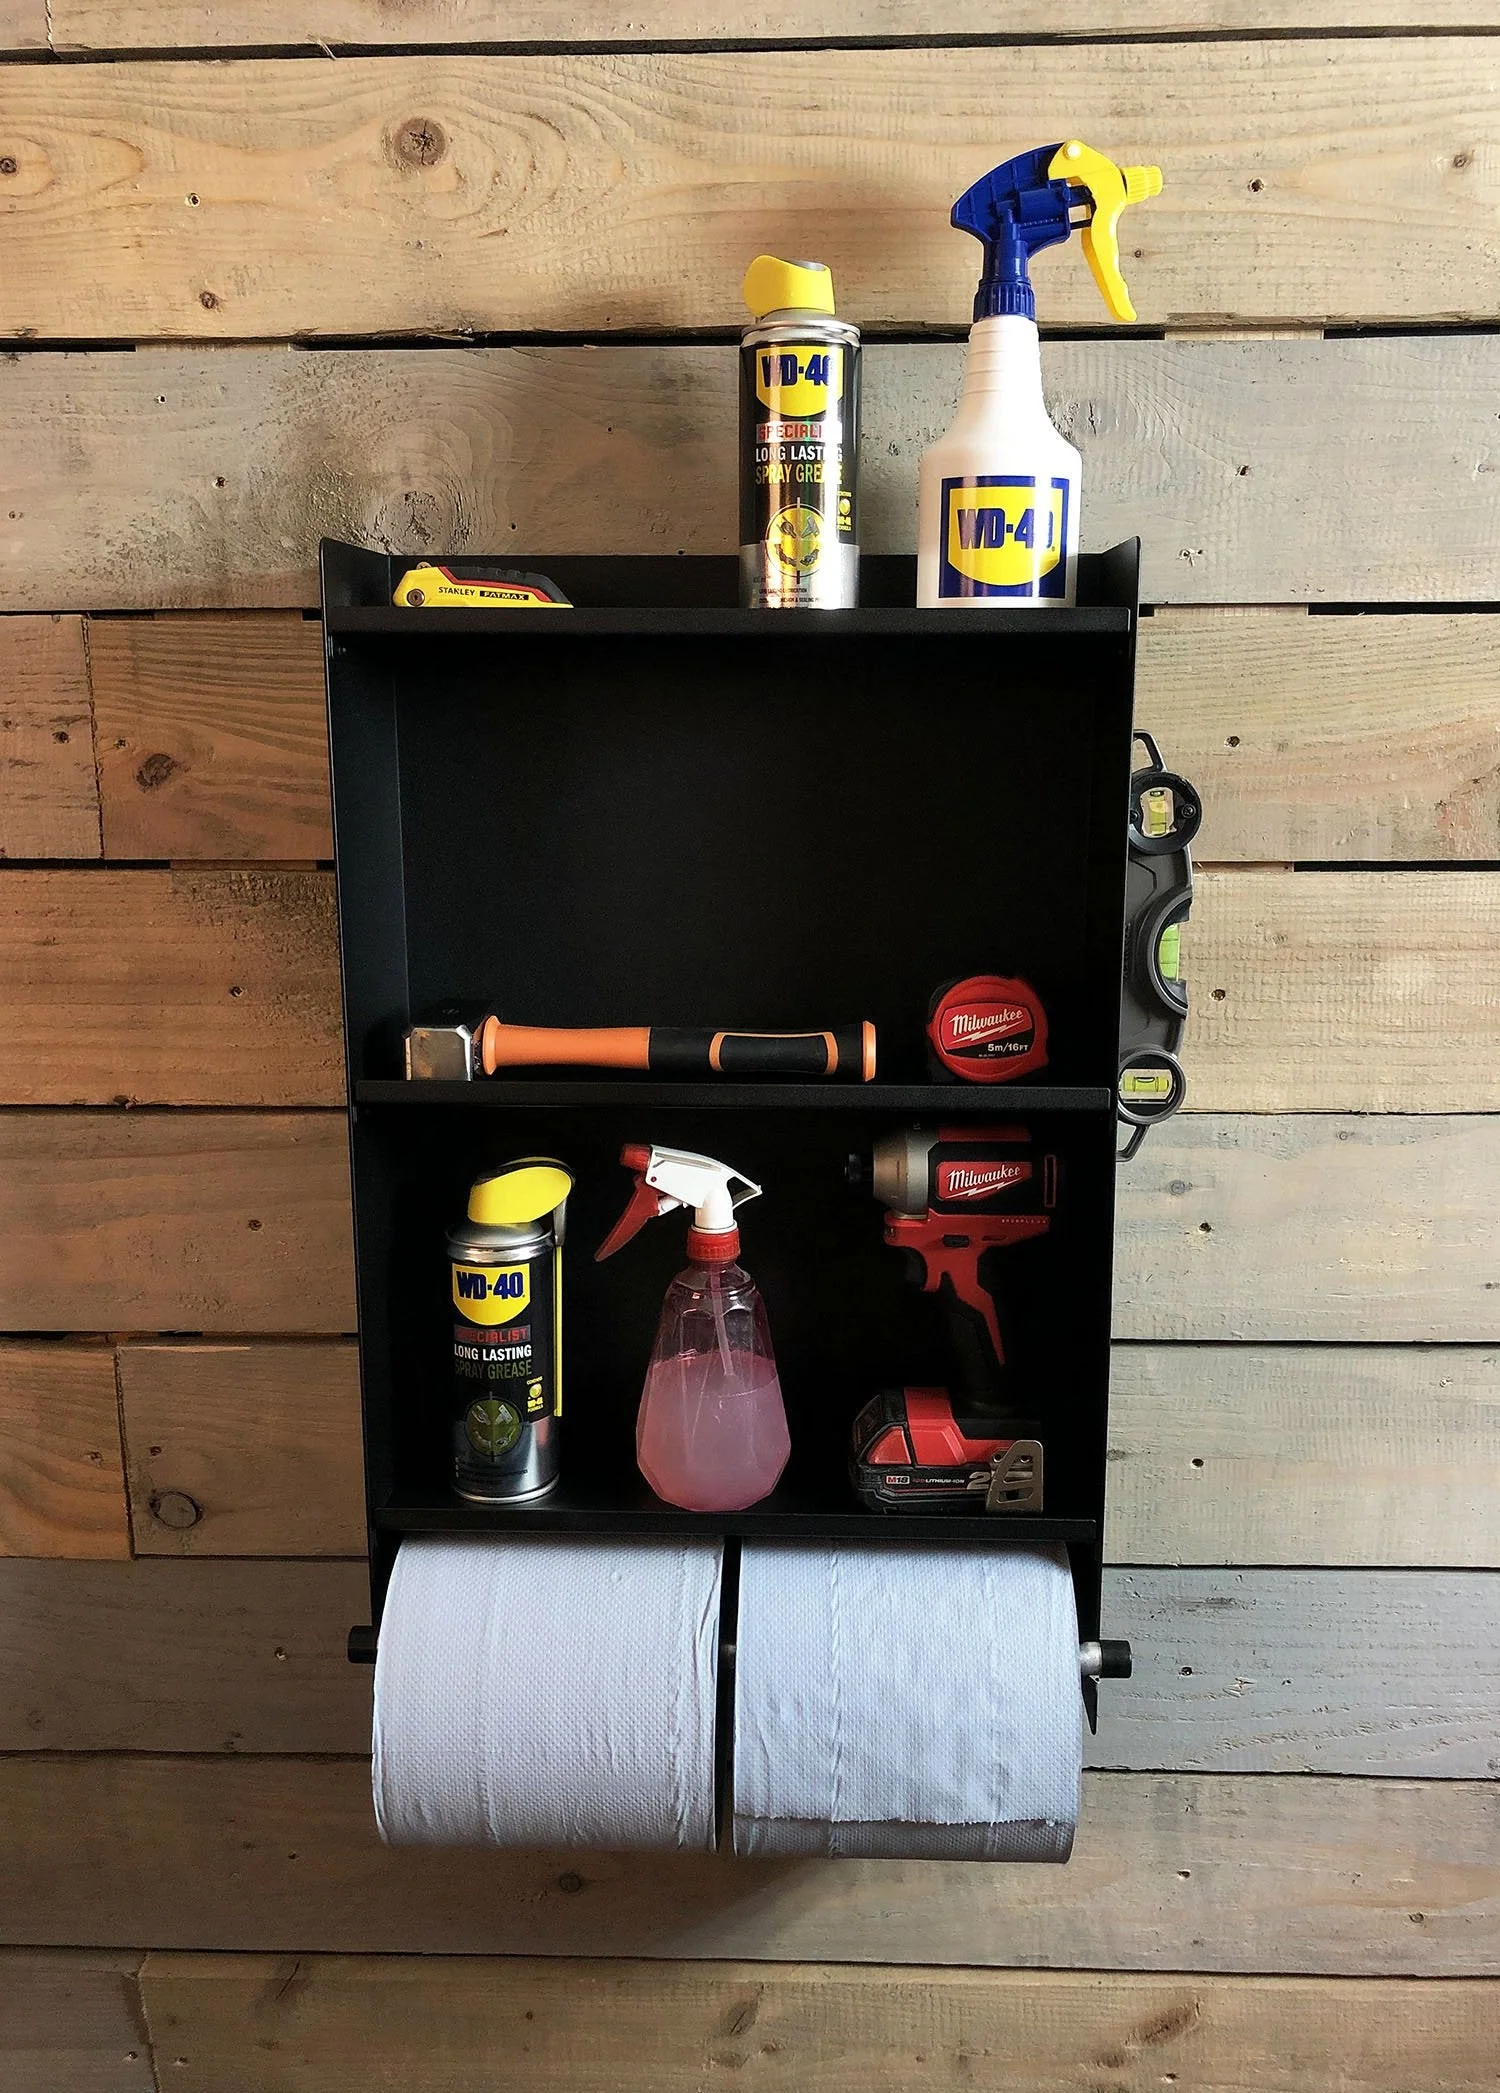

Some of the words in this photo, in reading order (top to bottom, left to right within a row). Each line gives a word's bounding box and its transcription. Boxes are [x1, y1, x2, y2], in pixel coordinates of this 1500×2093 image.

[756, 446, 786, 462] LONG
[756, 463, 793, 485] SPRAY
[957, 508, 1053, 549] WD-4
[438, 586, 476, 597] STANLEY
[483, 590, 525, 600] FATMAX
[948, 1008, 1024, 1037] Milwaukee
[946, 1164, 1021, 1191] Milwaukee
[456, 1270, 524, 1300] WD-40
[455, 1327, 528, 1343] SPECIALIST
[454, 1344, 479, 1361] LONG
[482, 1344, 532, 1361] LASTING
[454, 1359, 487, 1379] SPRAY
[487, 1359, 533, 1380] GREASE
